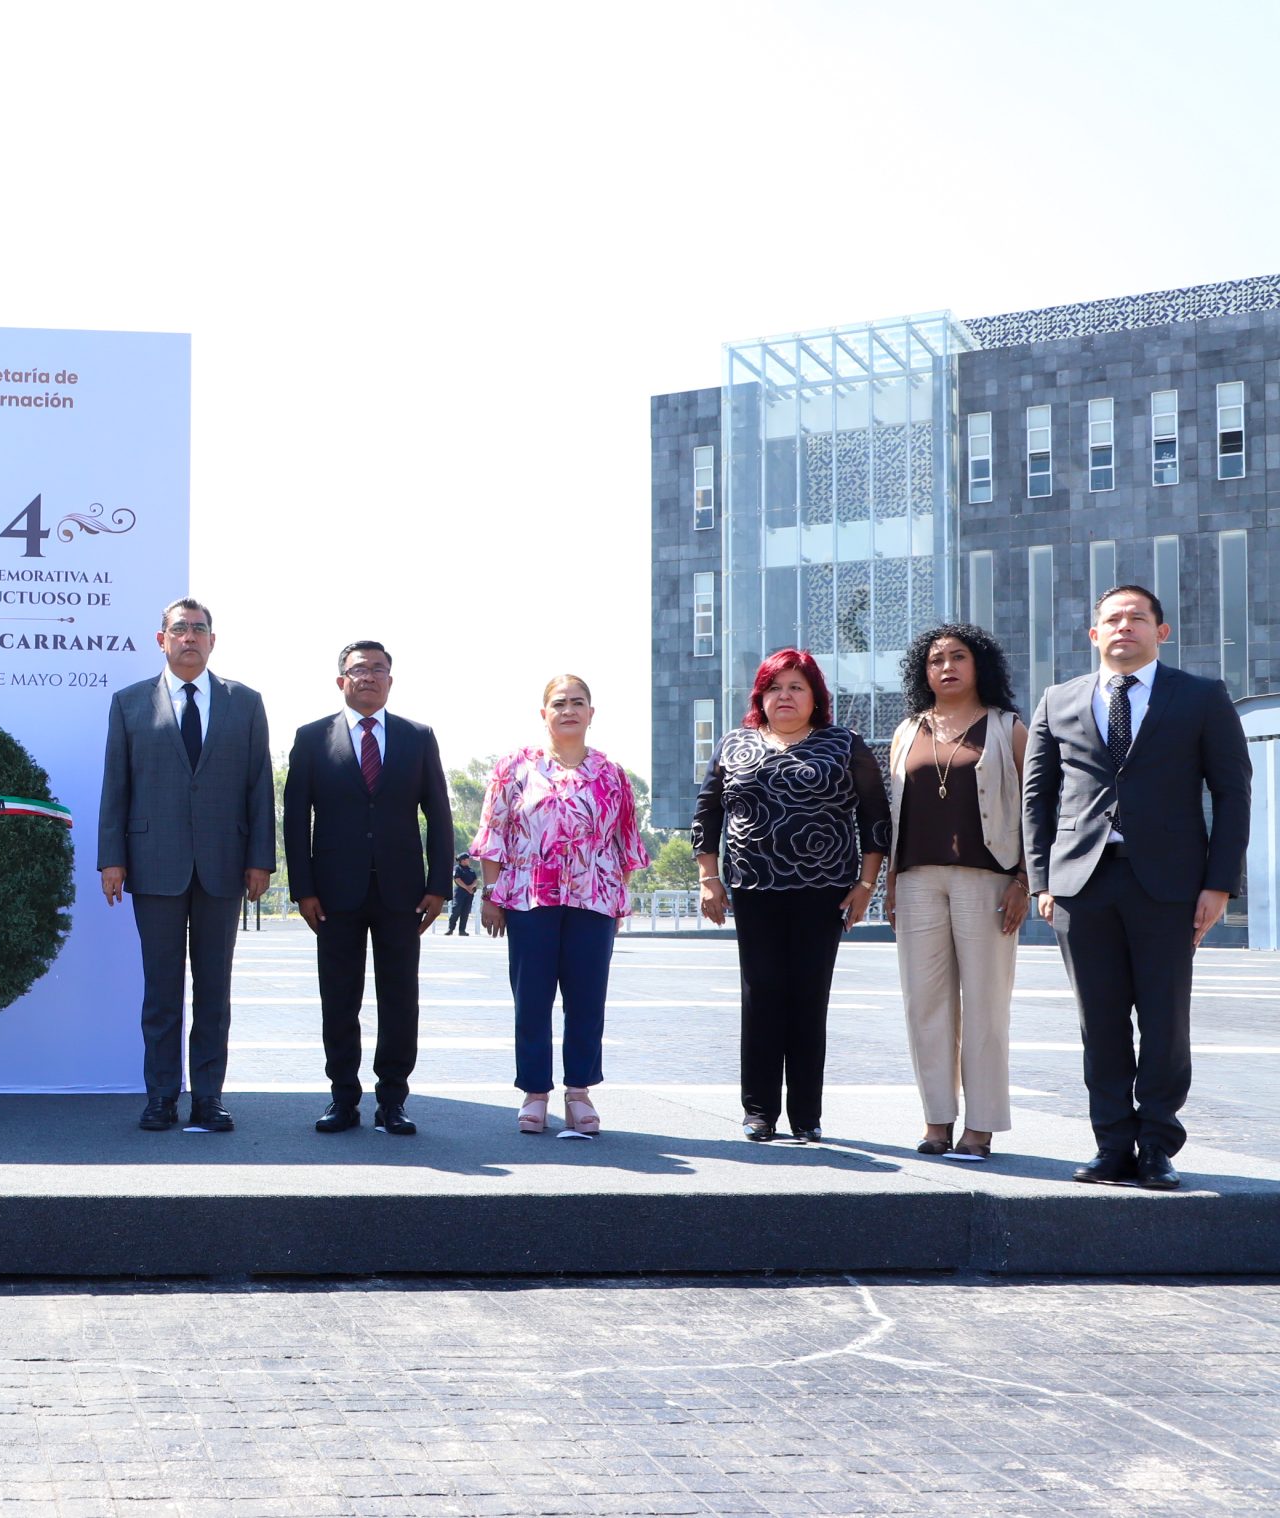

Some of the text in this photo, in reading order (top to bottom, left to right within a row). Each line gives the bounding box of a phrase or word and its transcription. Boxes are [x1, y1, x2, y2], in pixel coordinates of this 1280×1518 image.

[54, 369, 79, 385] de
[92, 571, 113, 584] AL
[87, 592, 111, 606] DE
[10, 673, 63, 687] MAYO
[68, 671, 109, 688] 2024
